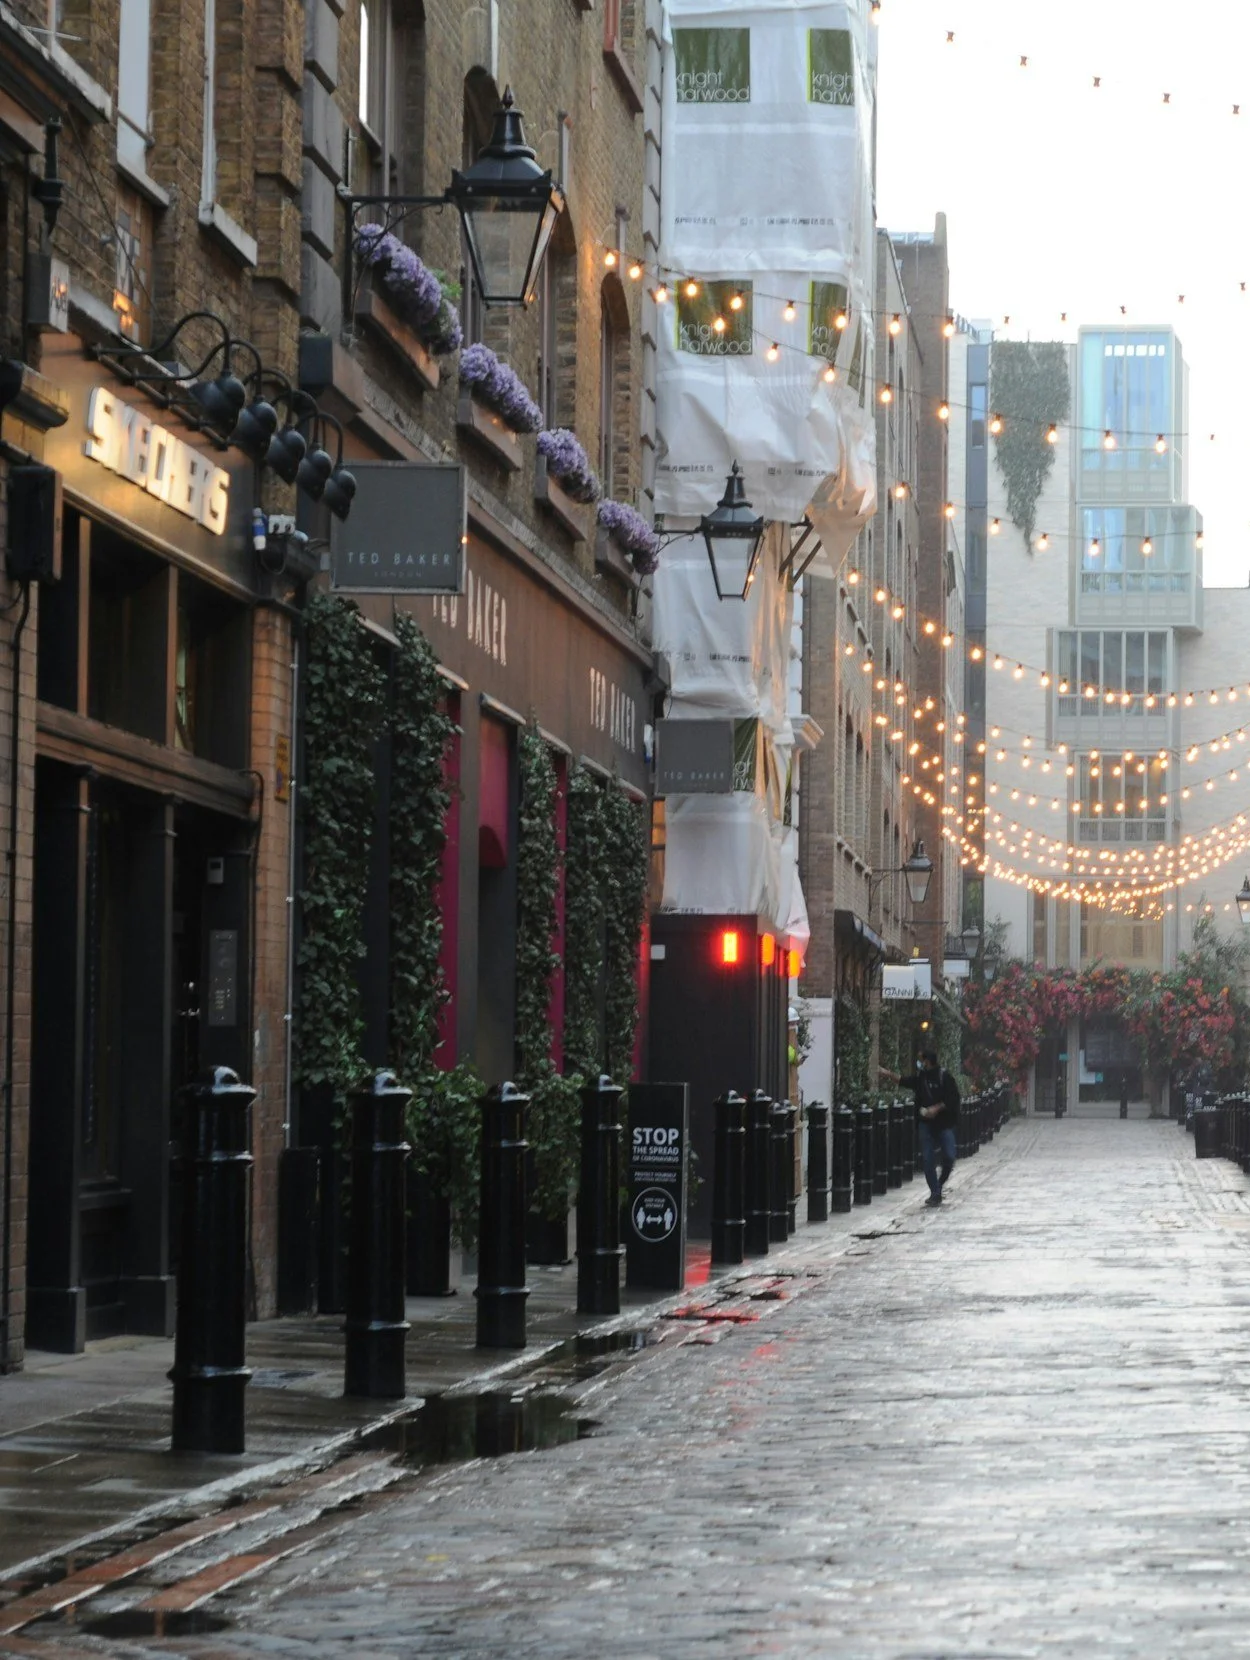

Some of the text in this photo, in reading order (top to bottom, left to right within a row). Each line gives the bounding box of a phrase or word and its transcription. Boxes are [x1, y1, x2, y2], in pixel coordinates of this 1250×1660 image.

[680, 338, 751, 354] harwood
[85, 386, 230, 536] SKECHERS
[347, 551, 451, 566] TED BAKER
[590, 667, 606, 731] TED
[885, 987, 913, 997] GANNI
[632, 1127, 679, 1145] STOP
[633, 1146, 679, 1155] THE SPREAD
